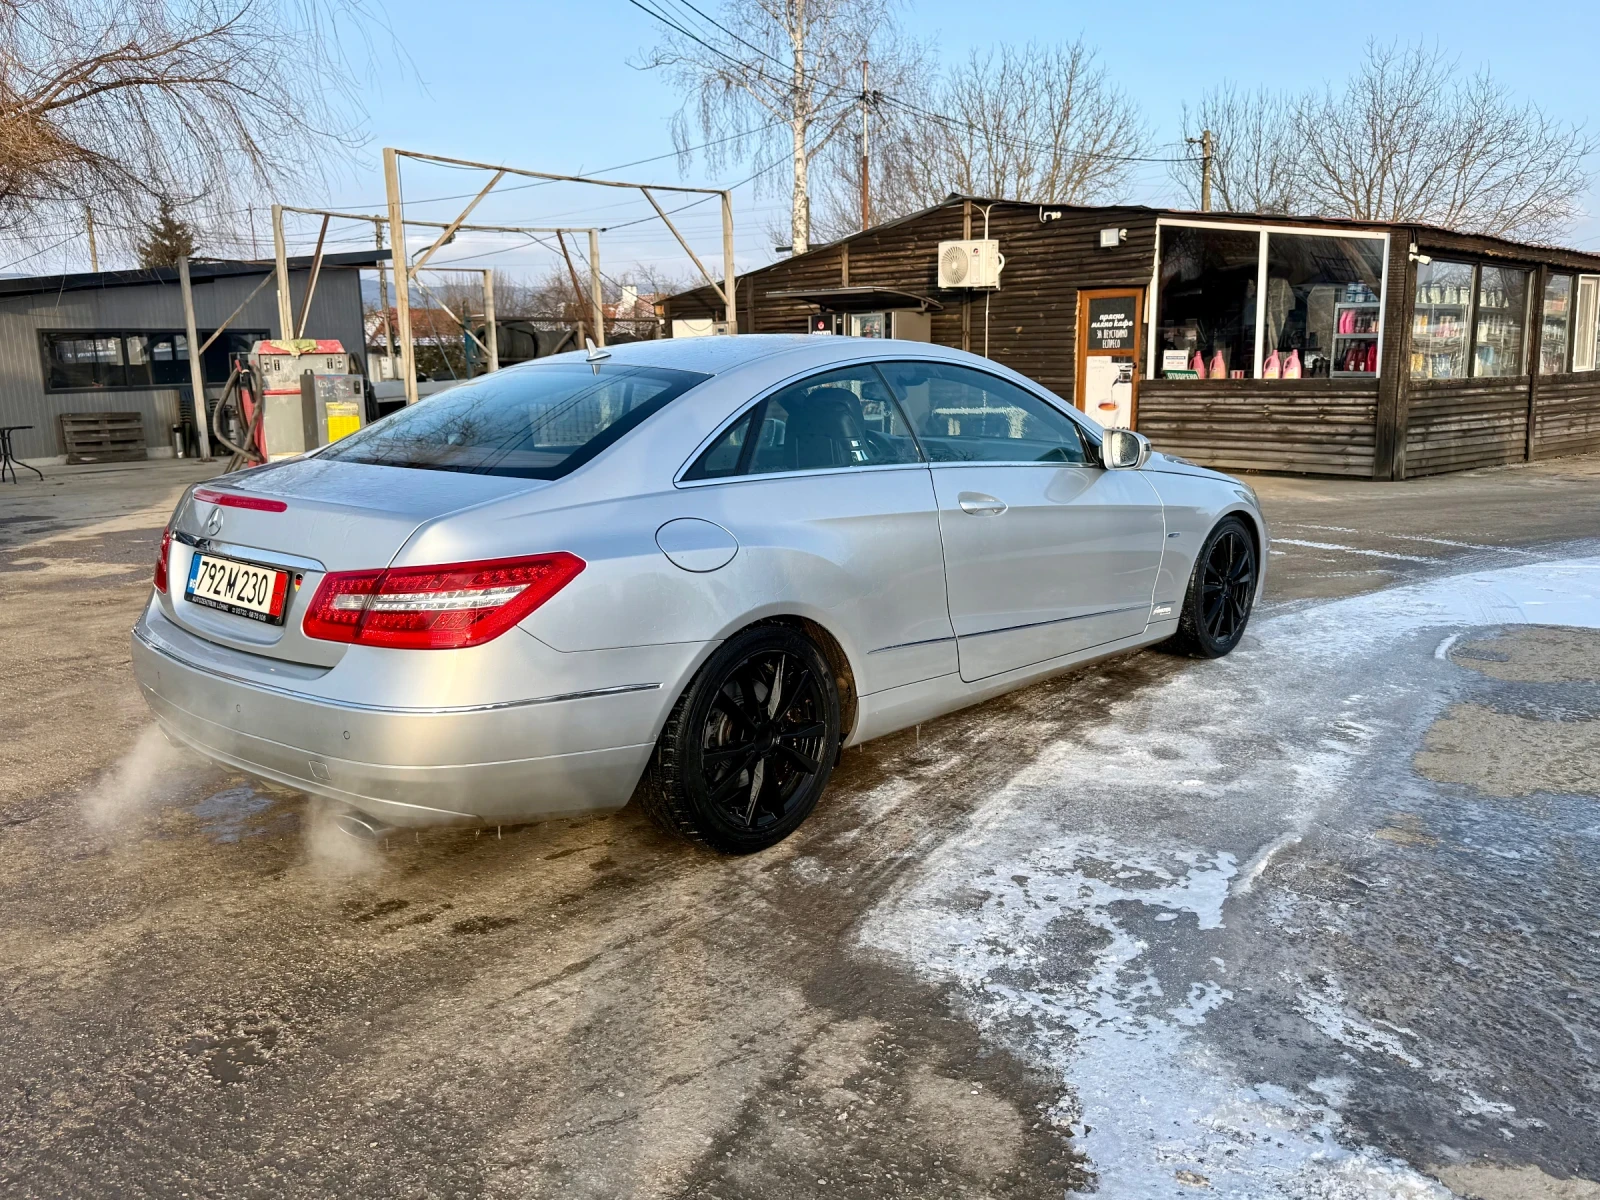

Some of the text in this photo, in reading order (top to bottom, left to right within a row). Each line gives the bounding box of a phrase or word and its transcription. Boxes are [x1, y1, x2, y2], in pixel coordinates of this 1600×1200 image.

[1099, 313, 1125, 322] прясно
[1113, 319, 1133, 328] кафе
[1096, 329, 1103, 339] ЗА
[1102, 339, 1121, 349] ЕСПРЕСО
[189, 578, 197, 589] BG
